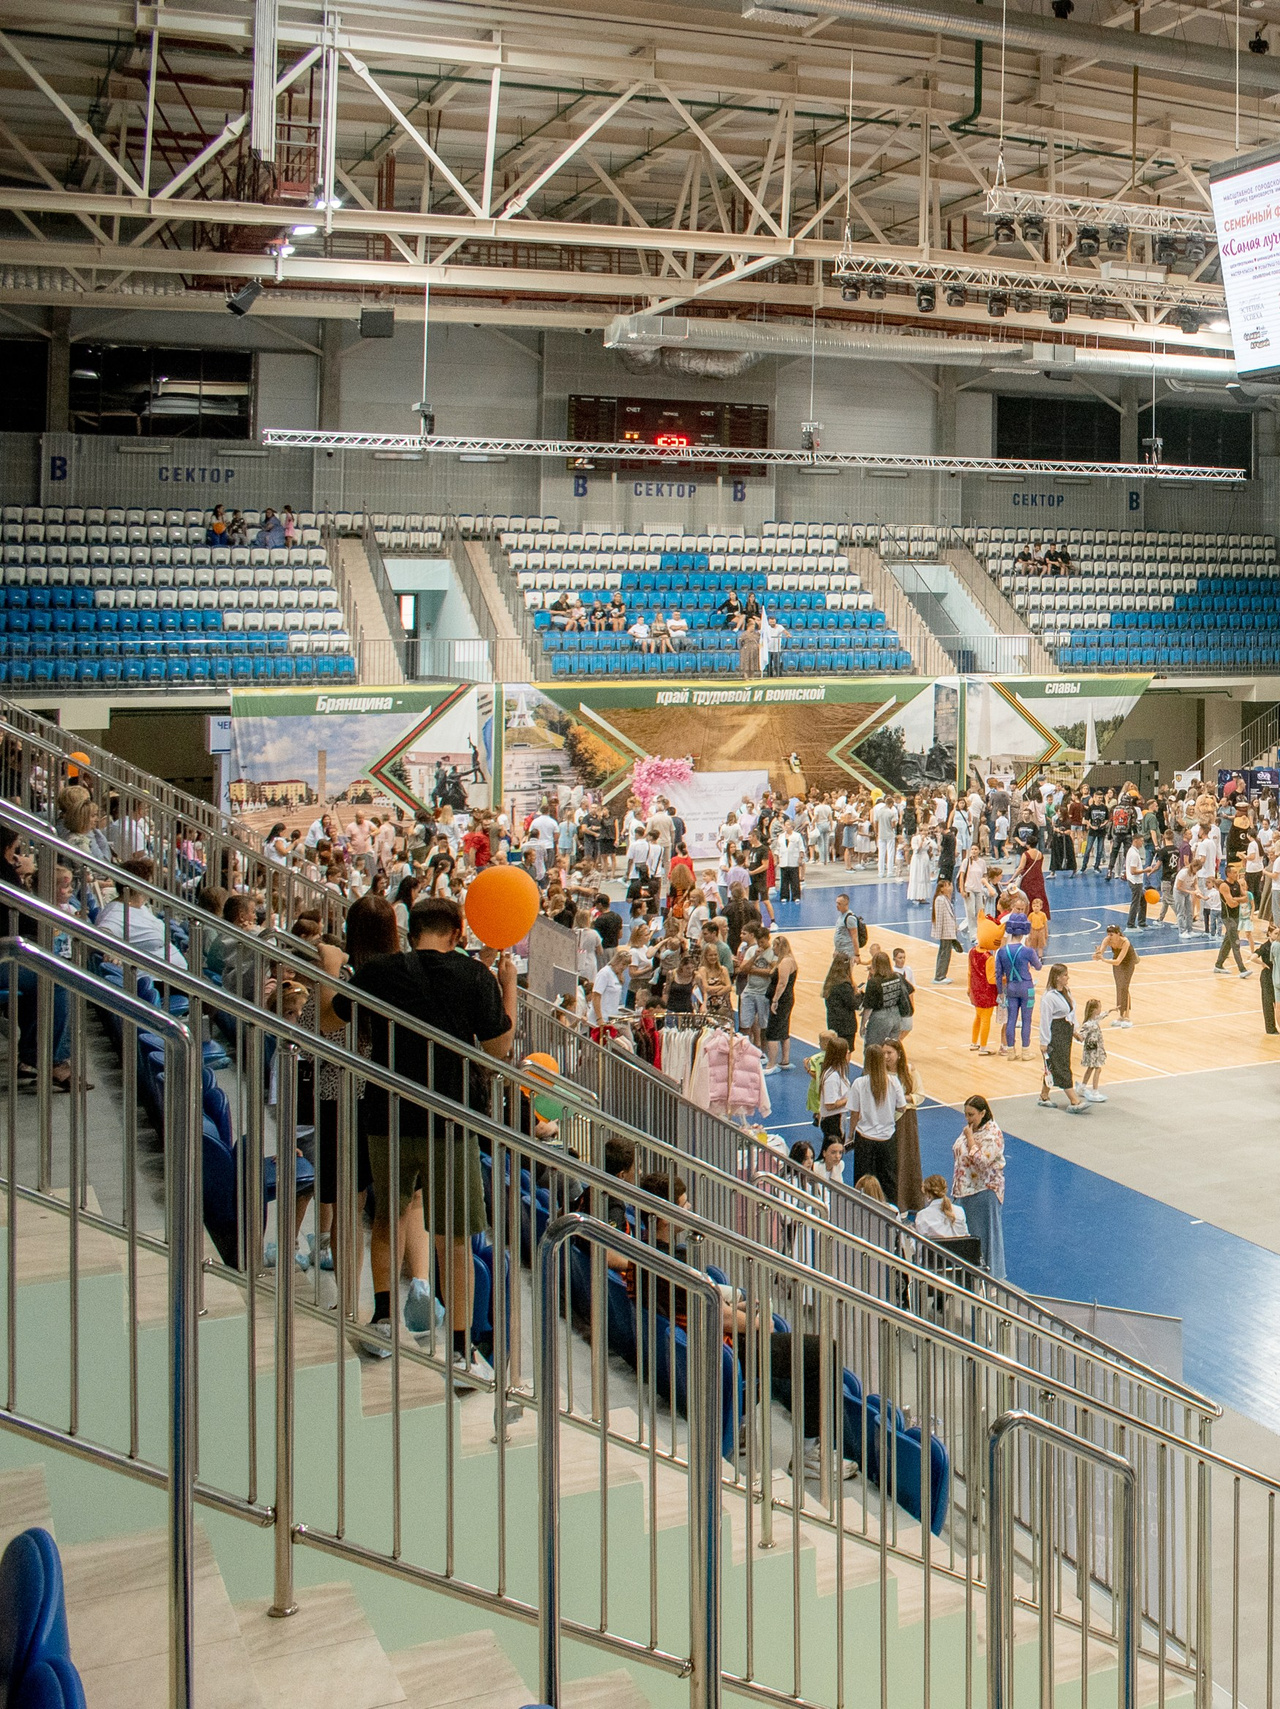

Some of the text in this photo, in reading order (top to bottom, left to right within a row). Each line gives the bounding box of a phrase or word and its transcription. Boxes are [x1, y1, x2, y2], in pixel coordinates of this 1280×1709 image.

[1224, 203, 1272, 232] СЕМЕЙНЫЙ
[1222, 237, 1260, 256] «Самая
[159, 466, 236, 484] СЕКТОР
[634, 482, 697, 499] СЕКТОР
[1013, 493, 1064, 507] СЕКТОР
[656, 685, 826, 706] край трудовой и воинской
[1045, 682, 1081, 694] славы
[316, 696, 393, 713] Брянщина
